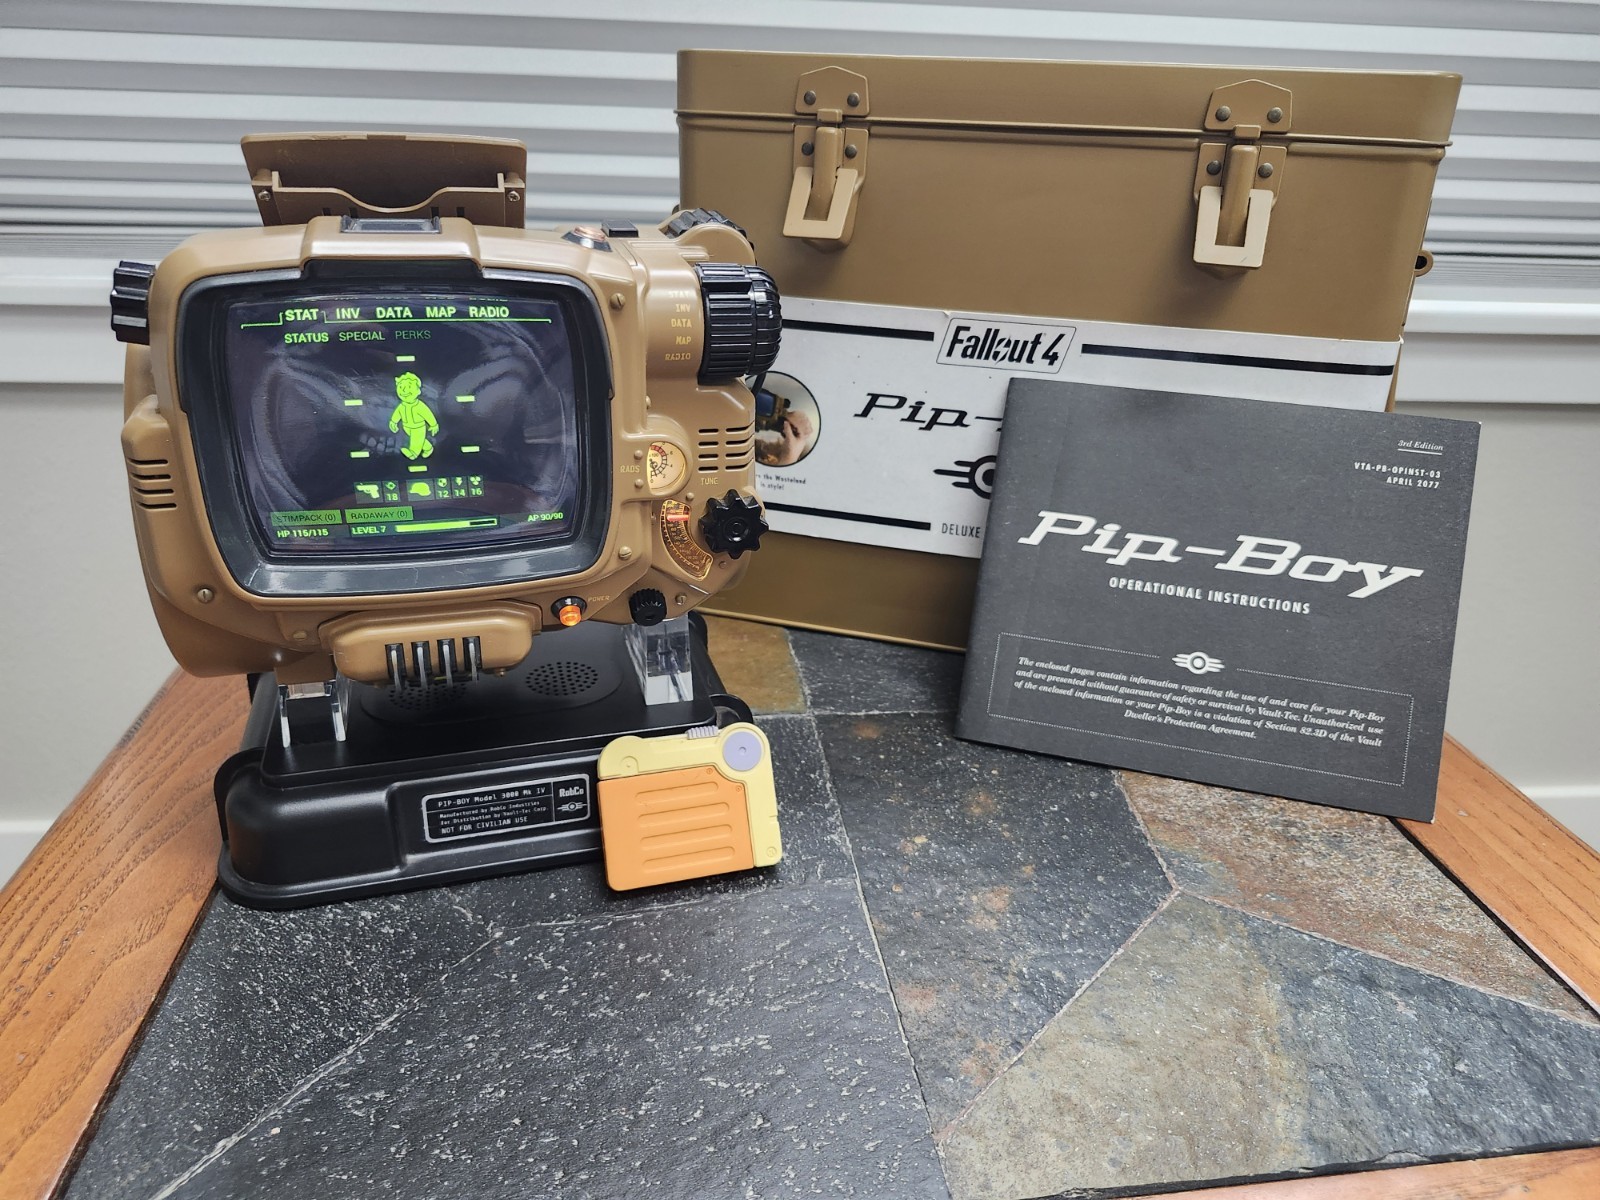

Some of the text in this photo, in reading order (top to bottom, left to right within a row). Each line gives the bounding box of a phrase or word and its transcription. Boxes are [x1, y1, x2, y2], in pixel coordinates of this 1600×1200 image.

[284, 306, 509, 321] STAT INV DATA MAP RADIO
[675, 303, 691, 313] INV
[671, 318, 692, 328] DATA
[284, 330, 431, 344] STATUS SPECIAL PERKS
[675, 336, 692, 345] MAP
[945, 325, 1066, 366] Fallout 4
[665, 352, 691, 361] RADIO
[853, 392, 1003, 432] Pip-
[1397, 439, 1443, 451] 3rd Edition
[620, 465, 640, 473] RADS
[1354, 461, 1441, 479] VTA-PB-OPINST-03
[700, 477, 719, 485] TUNE
[1386, 476, 1440, 489] APRIL 2077
[386, 493, 399, 501] 18
[438, 490, 449, 498] 12
[454, 489, 465, 497] 14
[276, 514, 322, 523] STIMPACK
[351, 510, 408, 520] RADAWAY (0)
[527, 512, 564, 522] AP 90/90
[276, 528, 329, 538] HP 115/115
[352, 526, 379, 535] LEVEL
[941, 522, 981, 539] DELUXE
[1017, 508, 1425, 599] Pip-Boy
[1108, 576, 1311, 615] OPERATIONAL INSTRUCTIONS
[1018, 656, 1034, 666] The
[1035, 661, 1071, 672] enclosed
[1070, 666, 1095, 676] pages
[1096, 670, 1127, 681] contain
[1129, 675, 1179, 690] information
[1180, 684, 1223, 698] regarding
[1225, 690, 1239, 699] the
[1258, 695, 1269, 706] of
[1269, 698, 1288, 707] and
[1289, 702, 1309, 710] care
[1309, 703, 1324, 712] for
[1325, 707, 1347, 716] your
[1348, 709, 1386, 723] Pip-Boy
[1015, 669, 1033, 678] and
[1046, 674, 1086, 687] presented
[1087, 680, 1119, 692] without
[1118, 686, 1161, 698] guarantee
[1162, 693, 1172, 702] of
[1172, 694, 1196, 706] safety
[1208, 700, 1244, 712] survival
[1245, 704, 1256, 715] by
[1258, 706, 1301, 721] Vault-Tec.
[1302, 714, 1365, 733] Unauthorized
[1367, 726, 1384, 735] use
[1013, 680, 1024, 689] of
[1024, 681, 1038, 690] the
[1038, 685, 1075, 697] enclosed
[1074, 689, 1123, 705] information
[1124, 698, 1135, 706] or
[1135, 700, 1157, 710] your
[1158, 702, 1192, 717] Pip-Boy
[1194, 709, 1202, 718] is
[1213, 712, 1251, 726] violation
[1253, 719, 1263, 729] of
[1264, 720, 1297, 733] Section
[1299, 726, 1328, 738] 82.3D
[1328, 731, 1339, 741] of
[1340, 732, 1355, 743] the
[1357, 735, 1382, 747] Vault
[1124, 709, 1257, 739] Dweller's Protection Agreement.
[438, 797, 470, 808] PIP-BOY
[474, 793, 497, 803] Model
[536, 786, 546, 794] IV
[559, 786, 584, 798] RobCo
[439, 808, 479, 819] Manufactured
[441, 815, 528, 835] NOT FOR CIVILIAN USE
